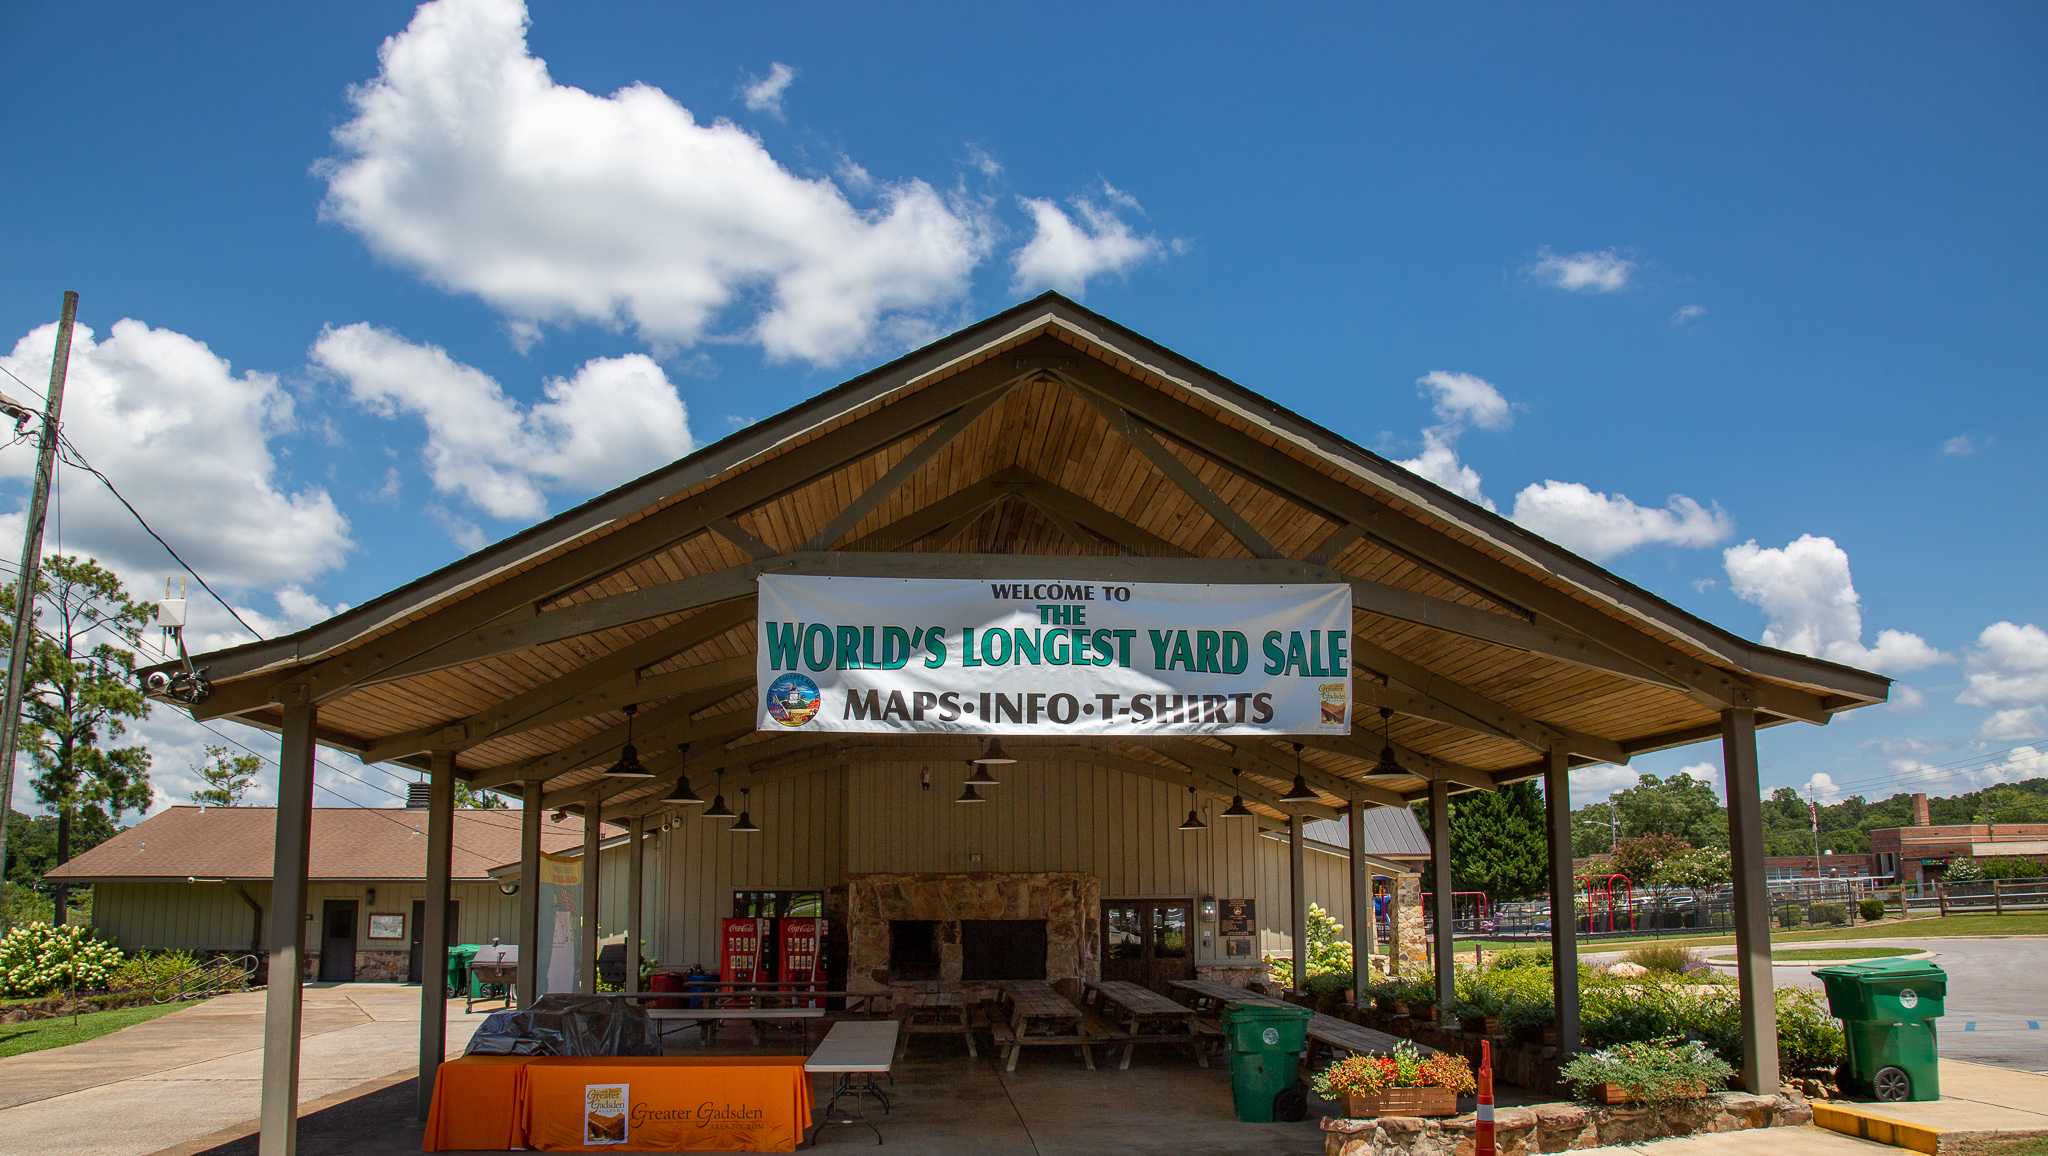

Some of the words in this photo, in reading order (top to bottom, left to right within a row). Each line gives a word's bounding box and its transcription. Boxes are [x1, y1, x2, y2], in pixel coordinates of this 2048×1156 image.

[991, 584, 1095, 601] WELCOME
[1102, 586, 1131, 602] TO
[1036, 604, 1086, 626] THE
[766, 622, 947, 671] WORLD'S
[962, 627, 1137, 668] LONGEST
[1148, 629, 1249, 675] YARD
[1262, 630, 1348, 677] SALE
[631, 1102, 692, 1129] Greater
[696, 1101, 763, 1128] Gadsden
